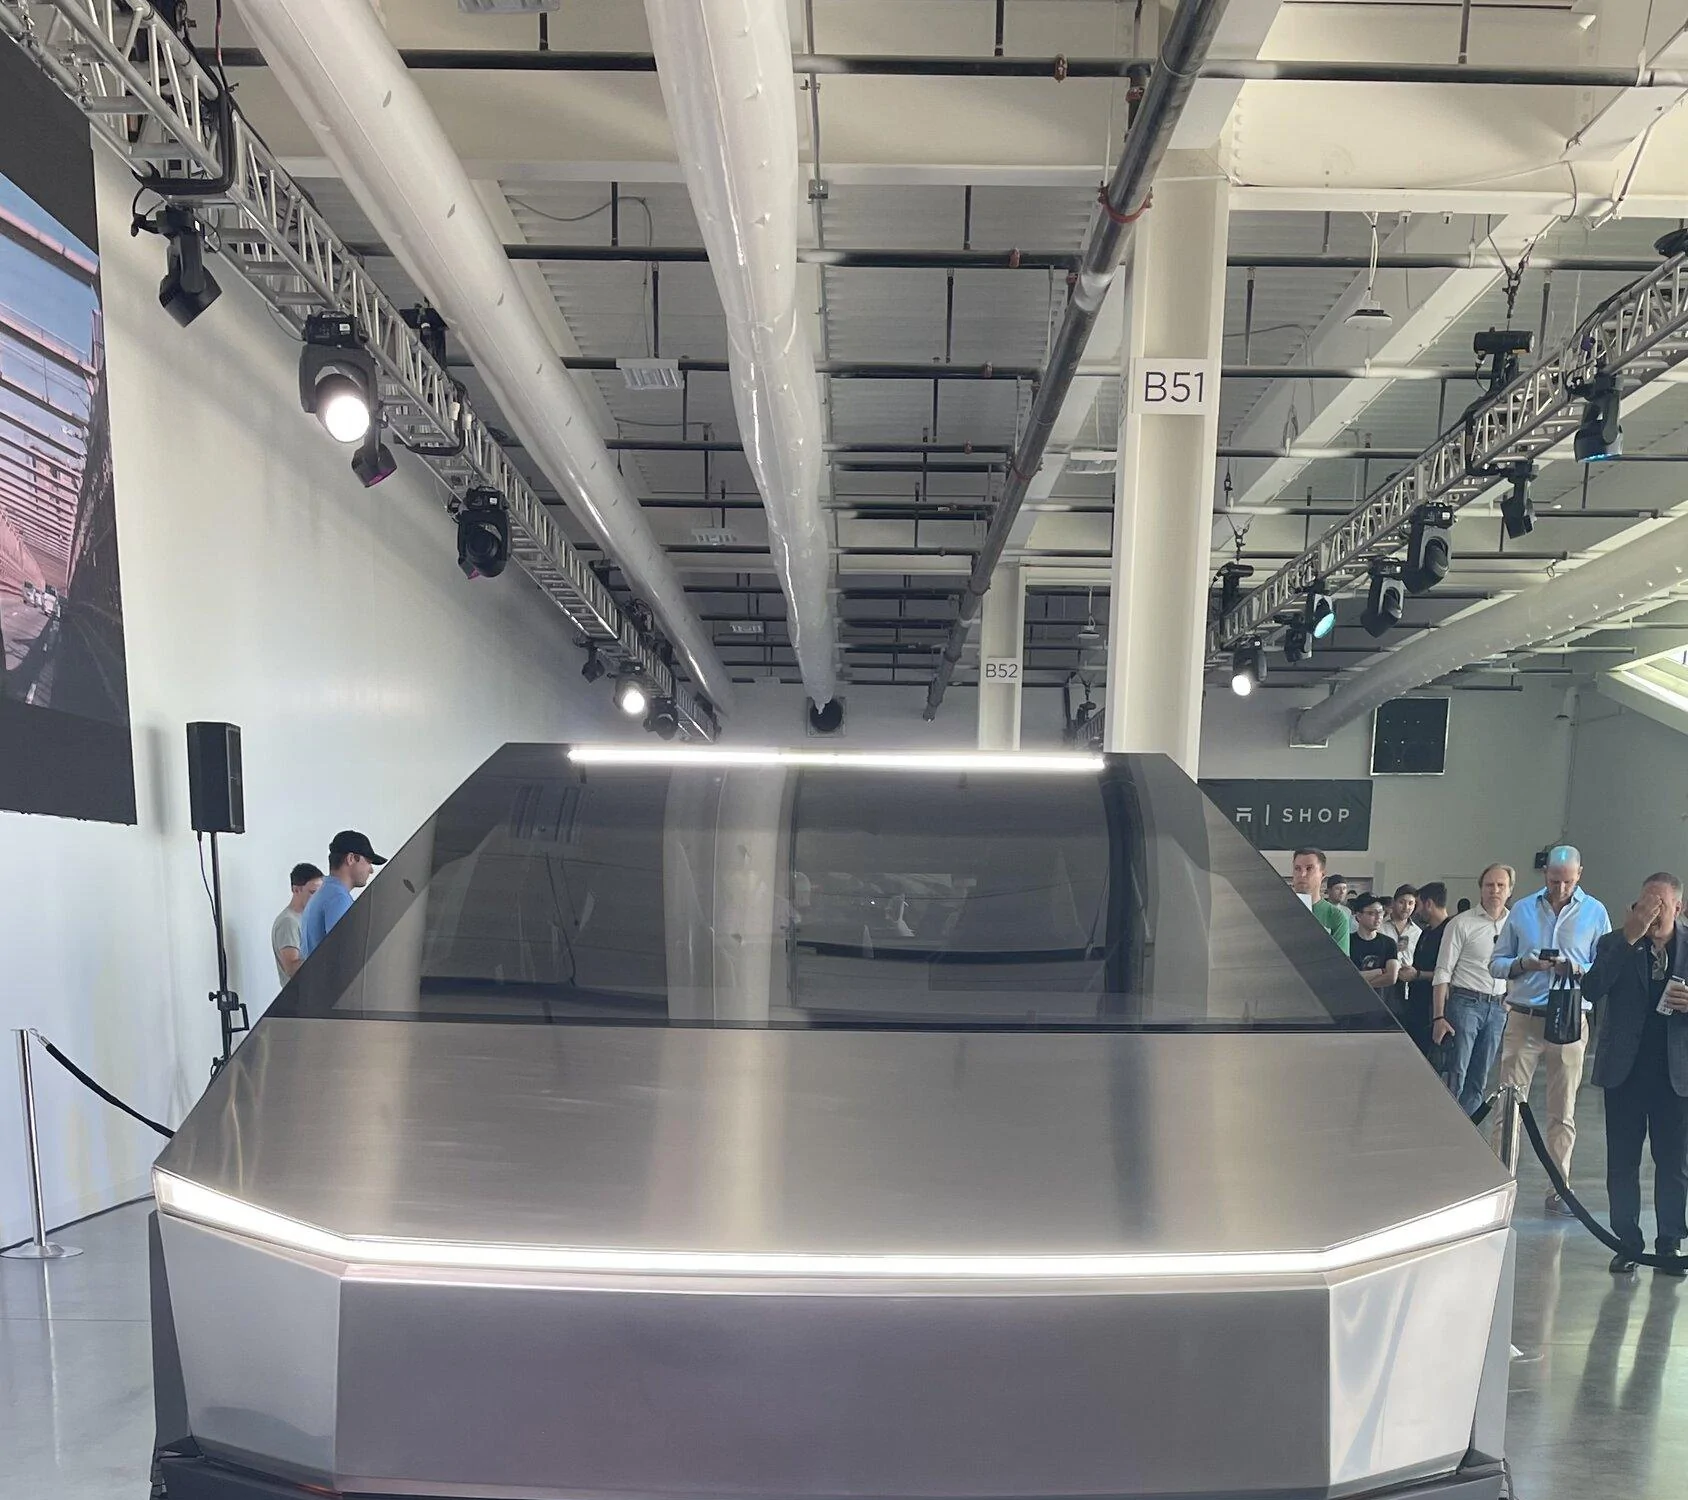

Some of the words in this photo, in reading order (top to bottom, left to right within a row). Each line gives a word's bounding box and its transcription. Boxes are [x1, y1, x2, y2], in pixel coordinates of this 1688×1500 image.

[1144, 371, 1204, 403] B51
[985, 663, 1018, 679] B52
[1282, 808, 1350, 823] SHOP
